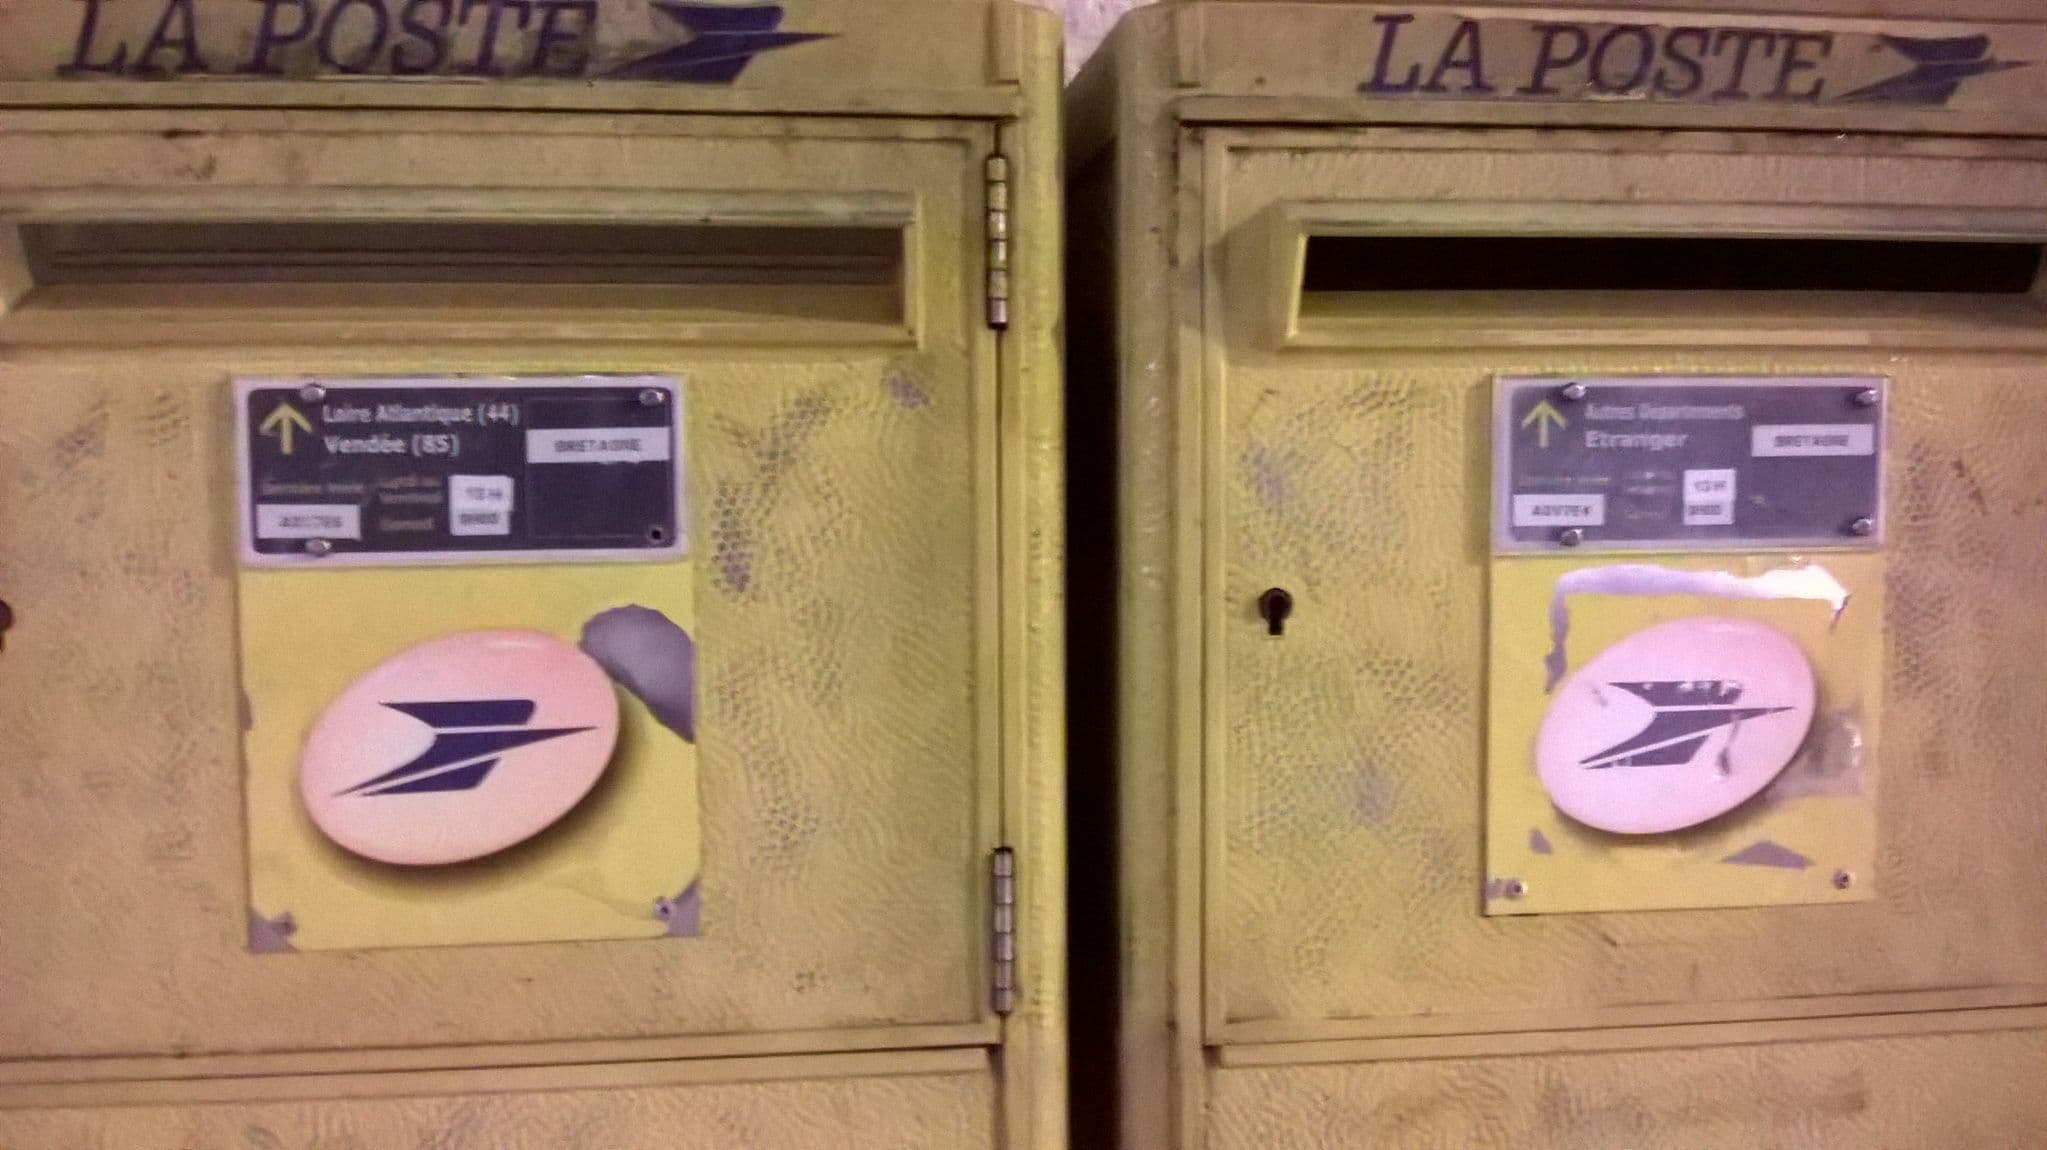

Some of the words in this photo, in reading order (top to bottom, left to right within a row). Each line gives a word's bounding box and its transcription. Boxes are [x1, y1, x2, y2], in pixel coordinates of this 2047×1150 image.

[57, 0, 208, 74] LA
[234, 0, 594, 77] POSTE
[1357, 14, 1497, 95] LA
[1516, 24, 1835, 102] POSTE
[323, 404, 371, 422] Loire
[477, 403, 520, 426] (44)
[324, 433, 407, 453] Vendée
